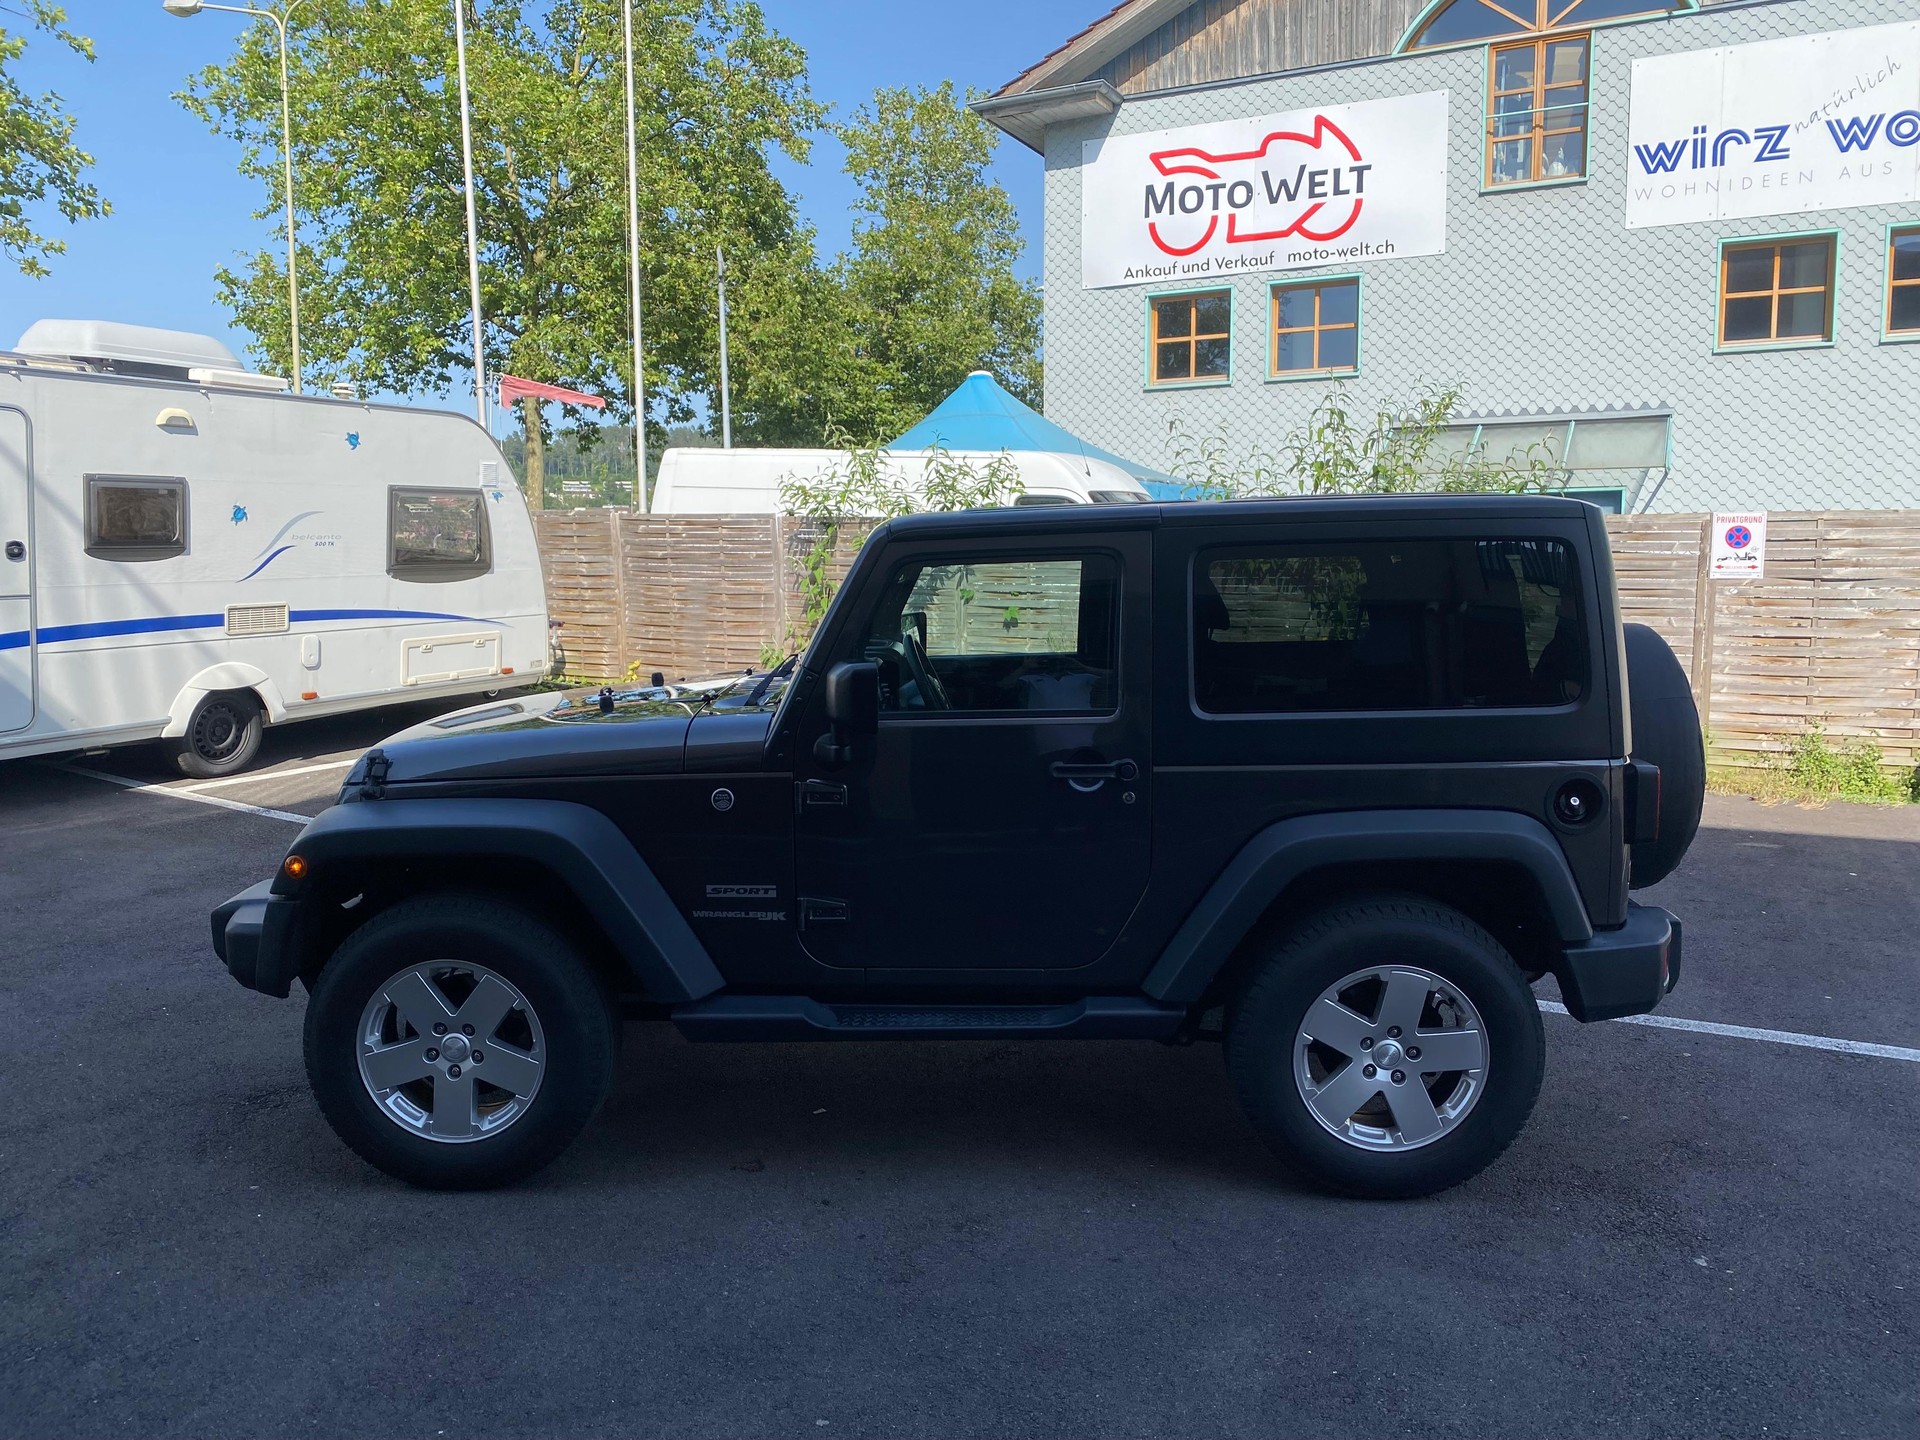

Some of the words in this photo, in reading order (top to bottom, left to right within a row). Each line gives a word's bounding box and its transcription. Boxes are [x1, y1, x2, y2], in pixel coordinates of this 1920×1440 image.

[1794, 55, 1902, 134] natürlich
[1635, 169, 1814, 200] WOHNIDEEN
[1838, 161, 1893, 180] AUS
[1123, 261, 1178, 280] Ankauf
[1182, 255, 1210, 274] und
[1214, 250, 1275, 270] Verkauf
[1287, 239, 1395, 263] moto-welt.ch
[706, 886, 776, 896] SPORT
